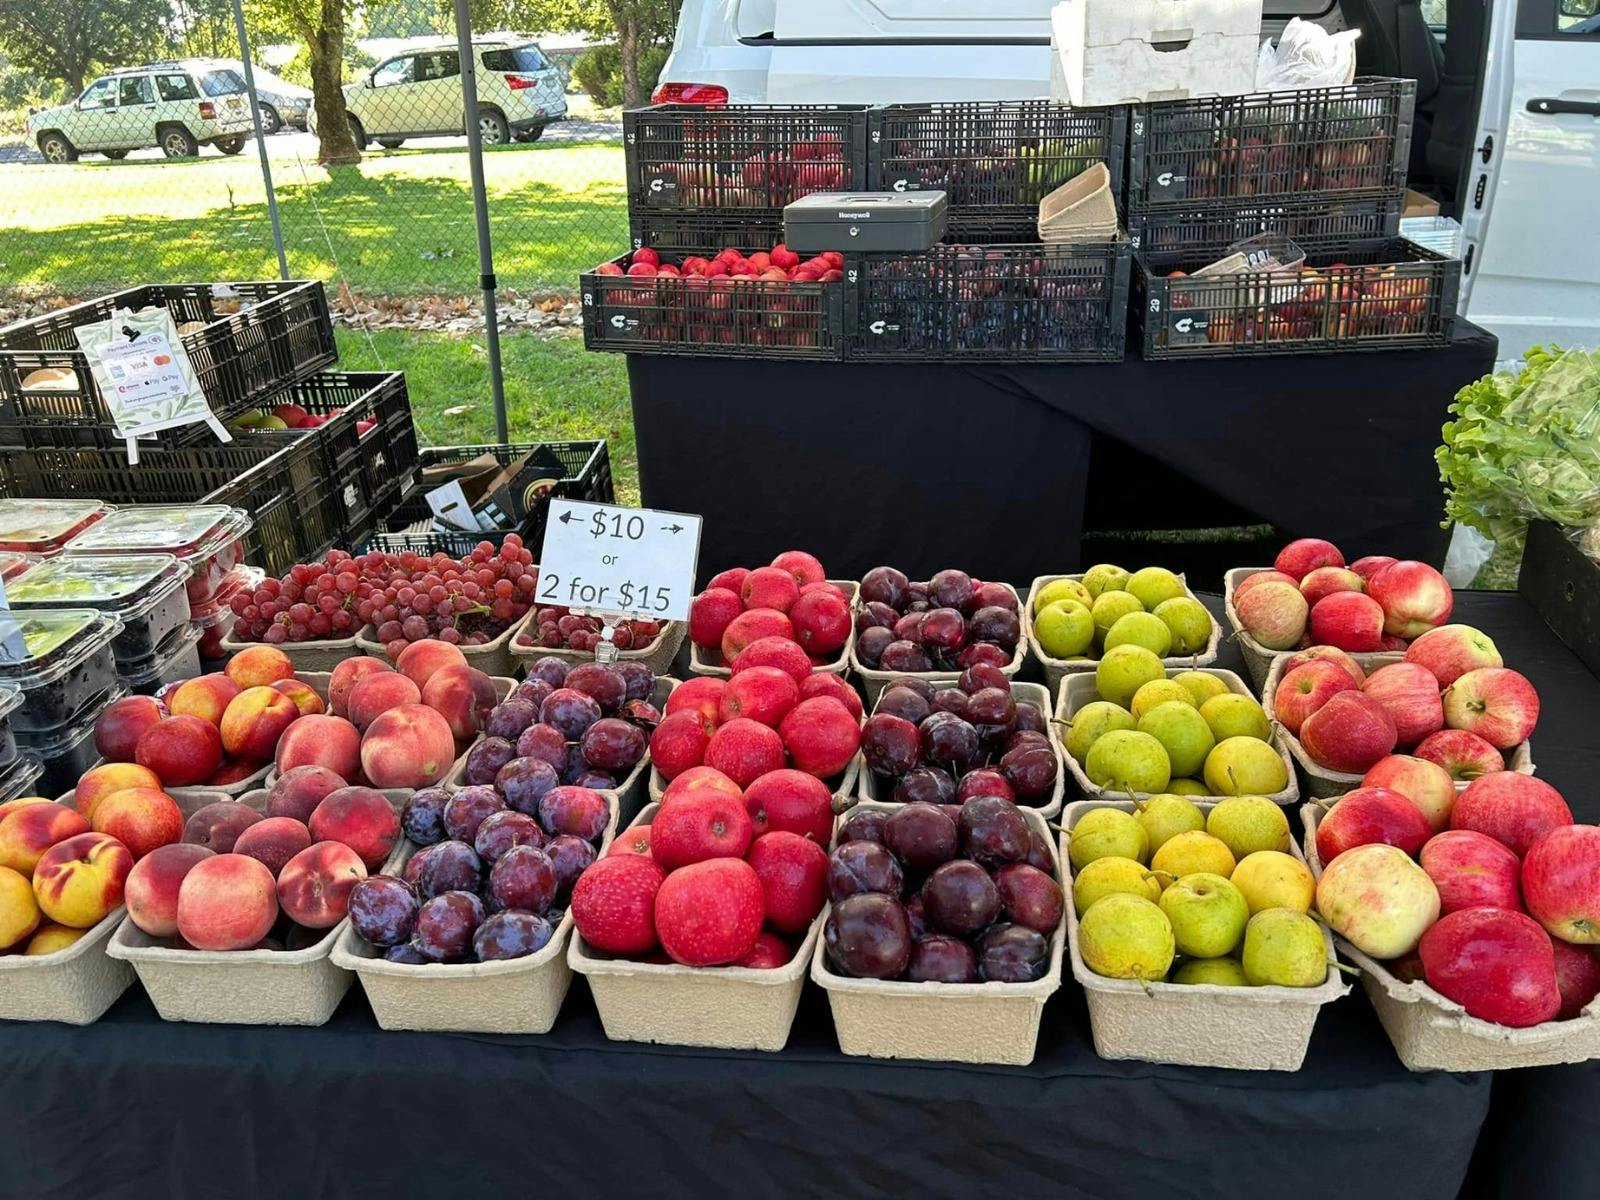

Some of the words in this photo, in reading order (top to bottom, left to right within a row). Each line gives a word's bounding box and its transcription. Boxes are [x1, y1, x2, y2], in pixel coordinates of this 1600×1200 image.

[1134, 122, 1144, 136] 42
[627, 132, 635, 144] 42
[872, 130, 880, 143] 42
[1132, 236, 1140, 248] 42
[848, 269, 857, 283] 42
[583, 293, 592, 306] 29
[1150, 299, 1160, 312] 29
[130, 361, 148, 369] VISA
[590, 508, 645, 540] $10
[602, 554, 619, 565] or
[541, 574, 560, 599] 2
[569, 577, 610, 604] for
[617, 580, 671, 612] $15
